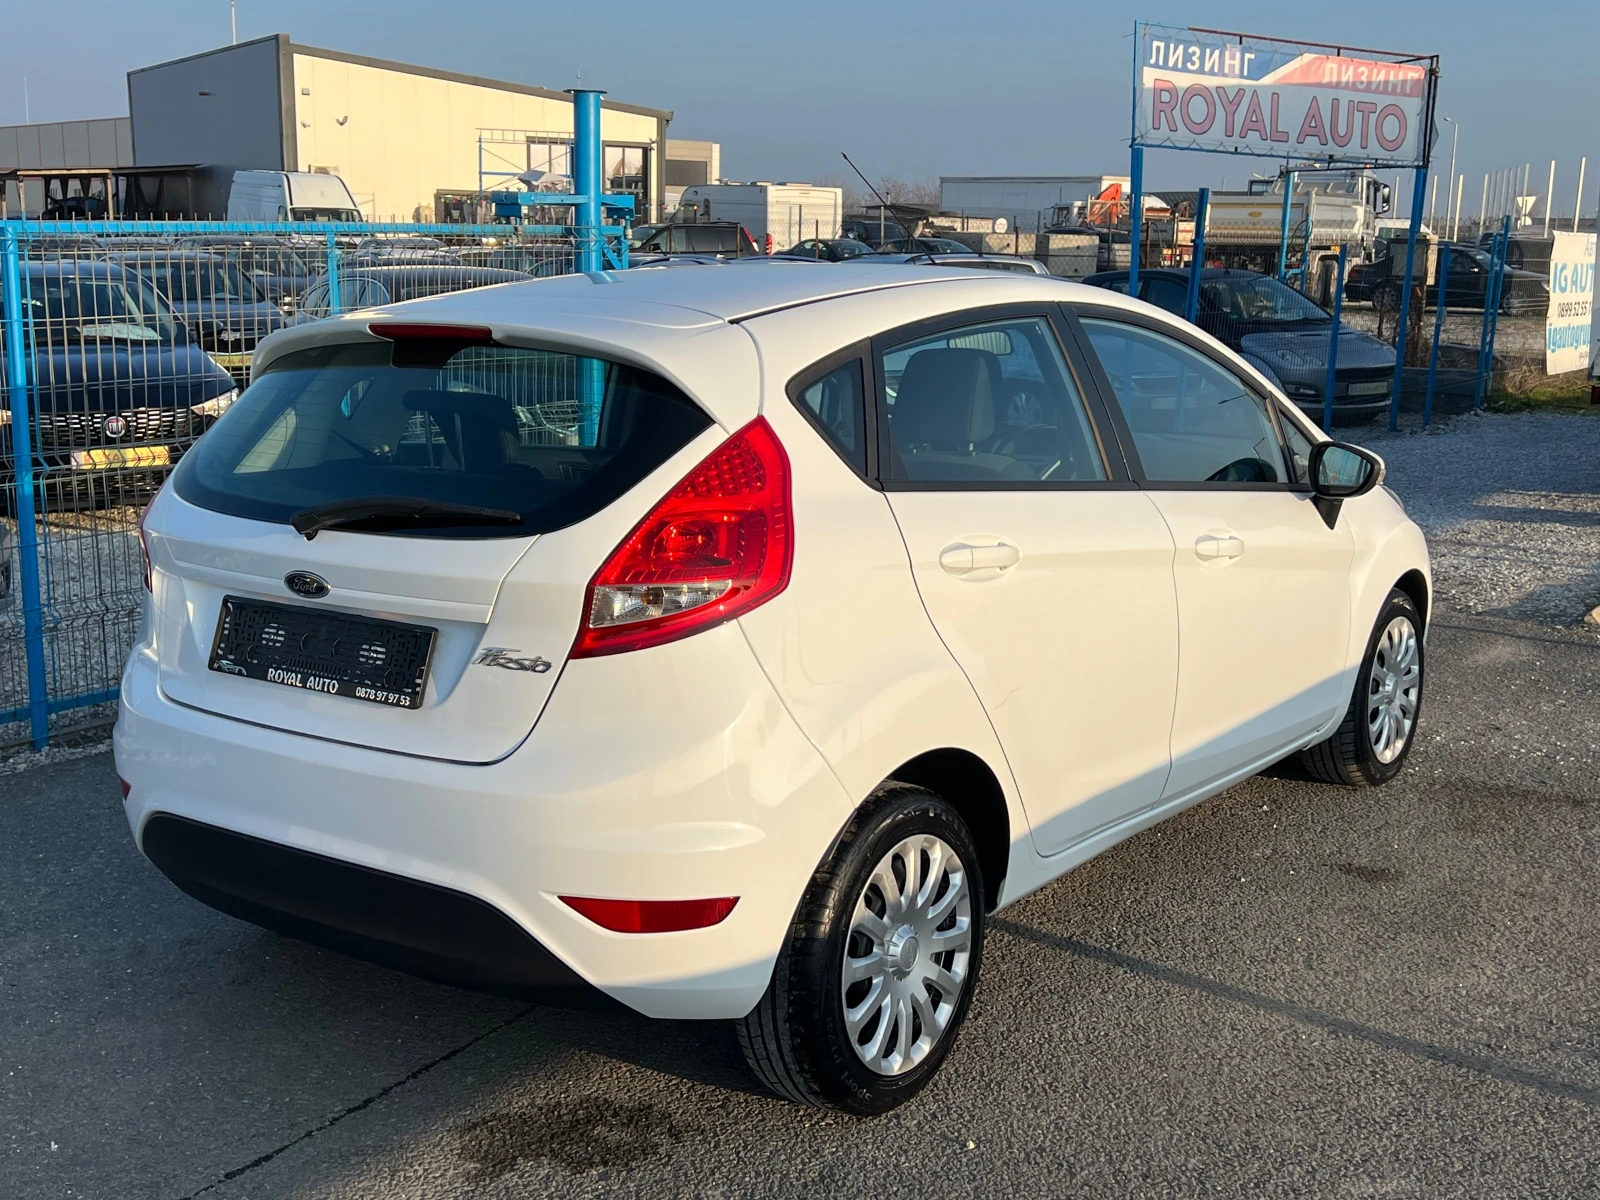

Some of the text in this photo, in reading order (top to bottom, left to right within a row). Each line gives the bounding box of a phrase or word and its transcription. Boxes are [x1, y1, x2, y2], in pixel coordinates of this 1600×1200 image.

[1149, 40, 1256, 77] ЛИЗИНГ
[1321, 62, 1420, 94] ЛИЗИНГ
[1151, 77, 1408, 152] ROYAL AUTO
[1552, 263, 1568, 294] IG
[292, 576, 317, 593] Ford
[267, 668, 411, 706] ROYAL AUTO 0878 97 97 53
